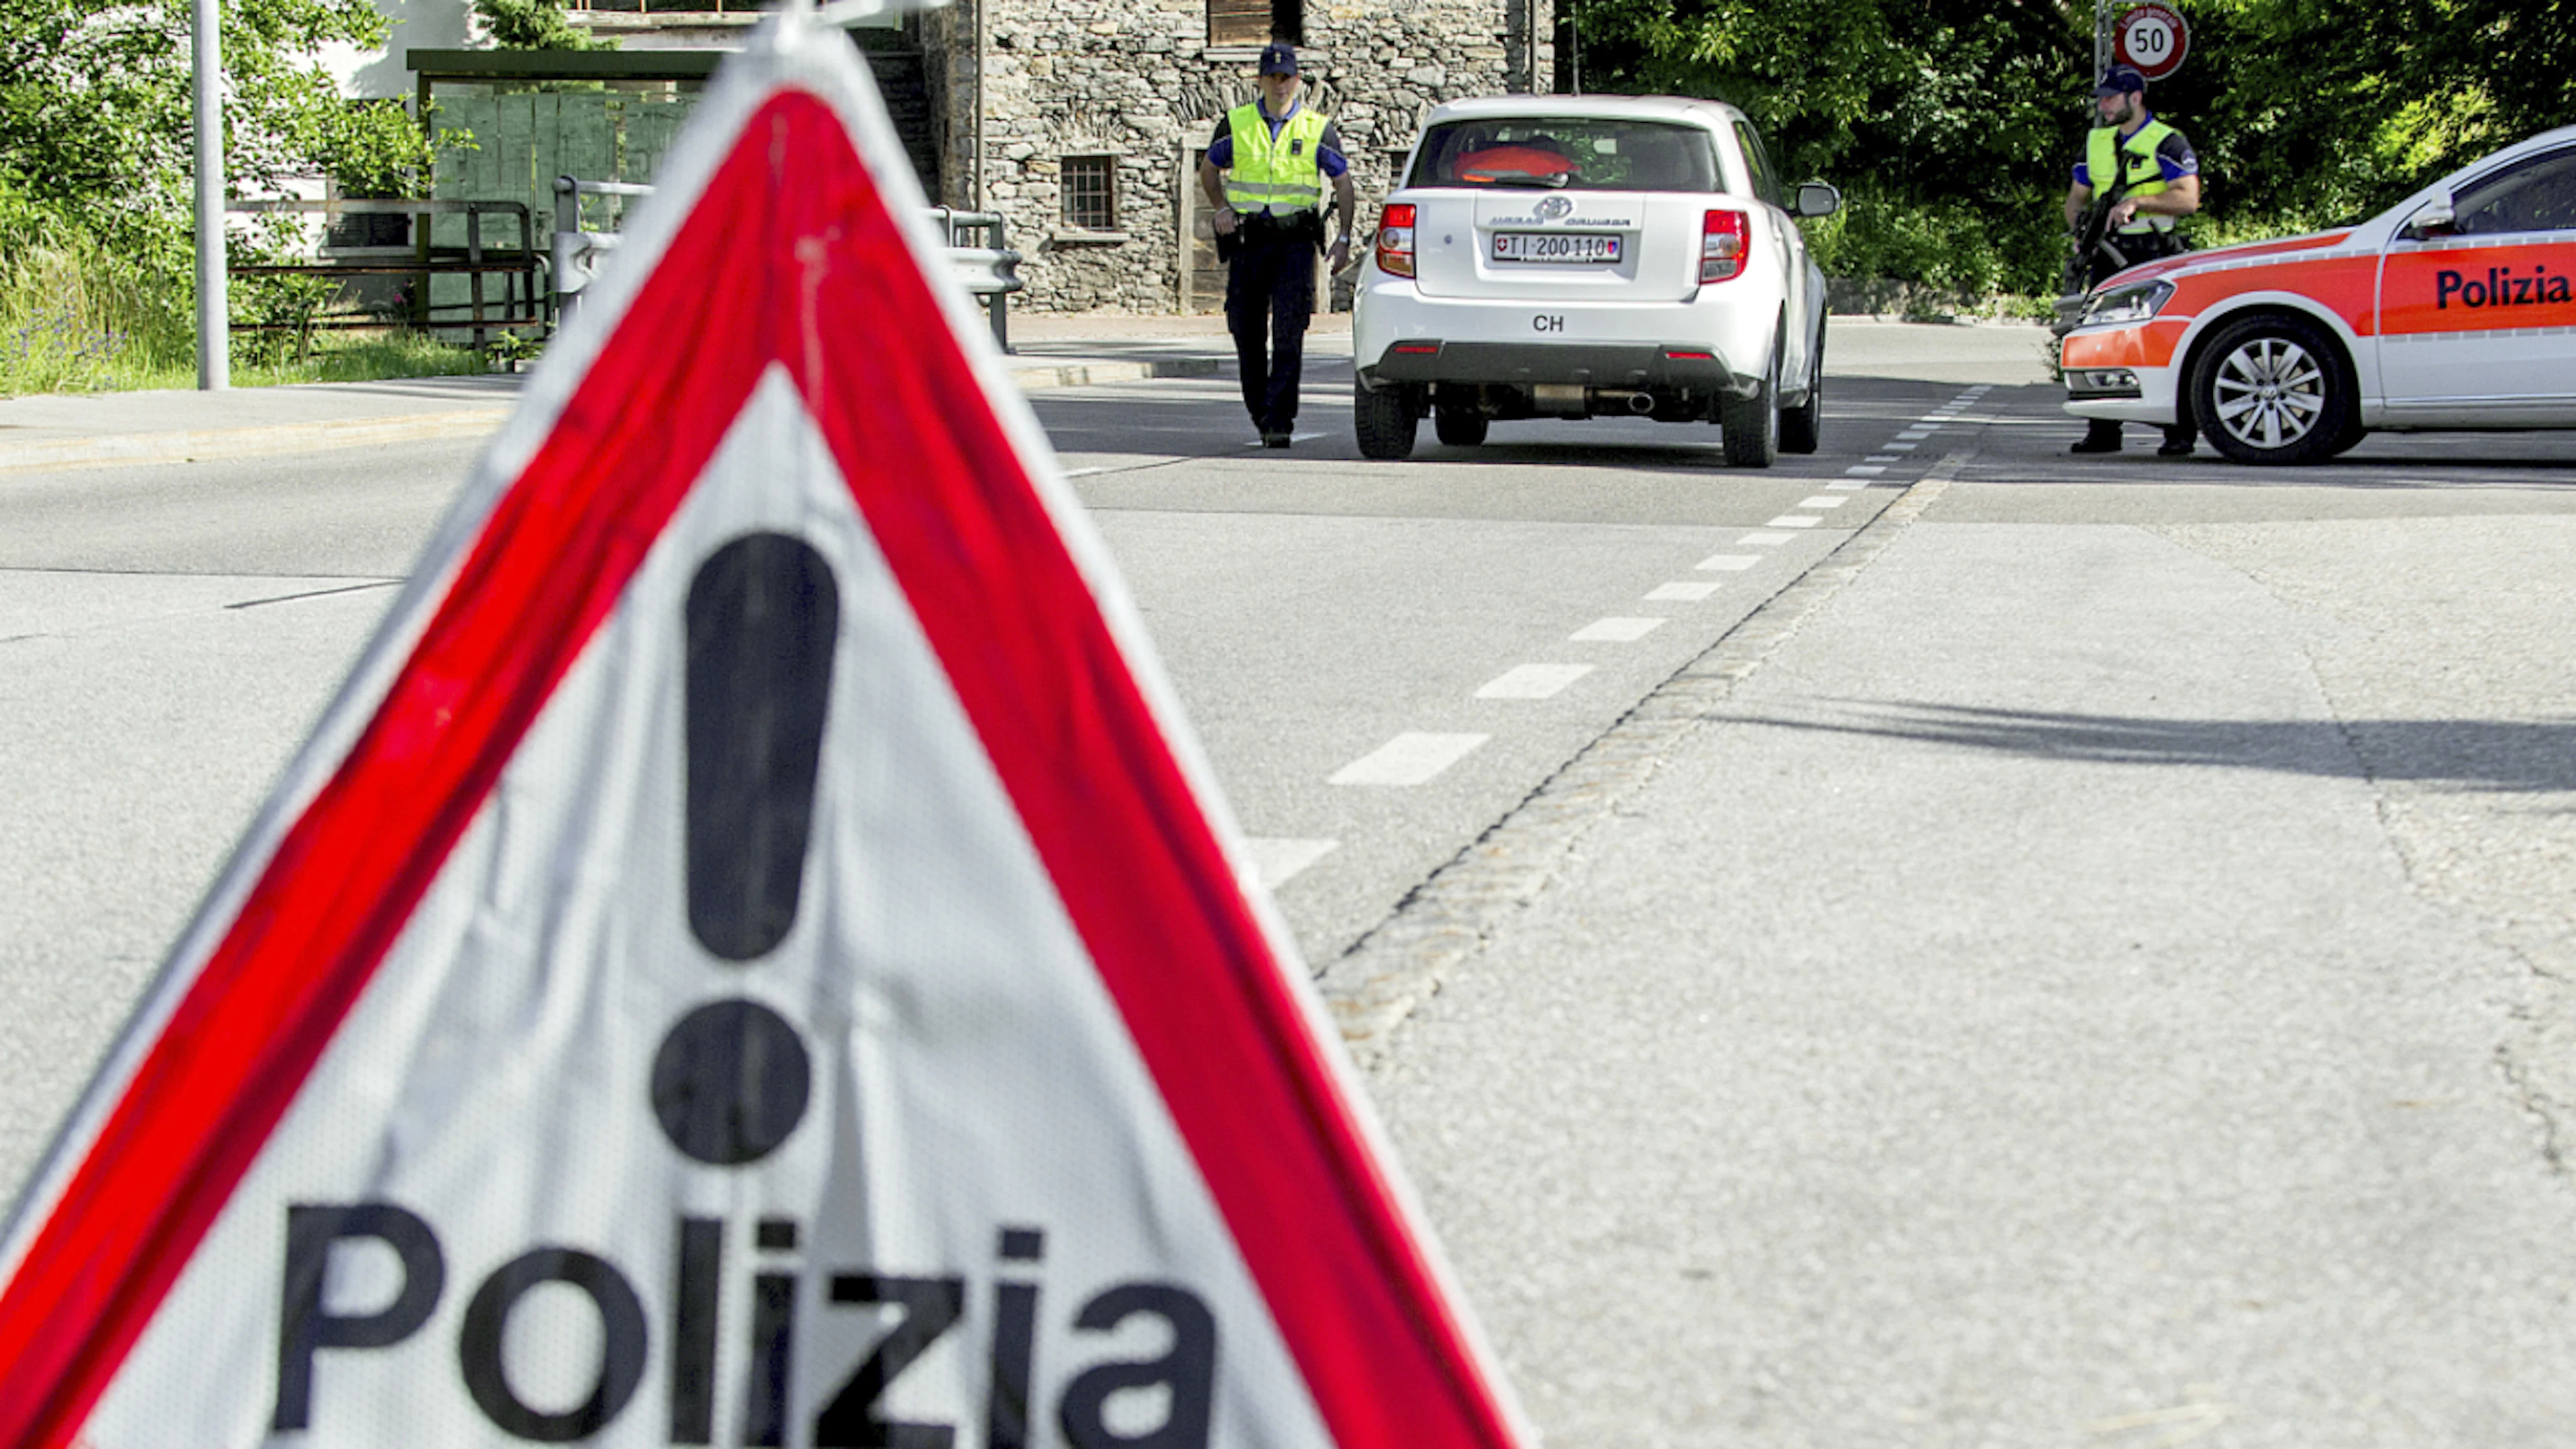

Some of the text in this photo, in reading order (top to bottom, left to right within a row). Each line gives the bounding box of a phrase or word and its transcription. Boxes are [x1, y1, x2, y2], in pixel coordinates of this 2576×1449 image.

[2135, 28, 2163, 52] 50
[2436, 265, 2573, 309] Polizia
[1533, 315, 1564, 332] CH
[272, 1203, 1218, 1449] Polizia
